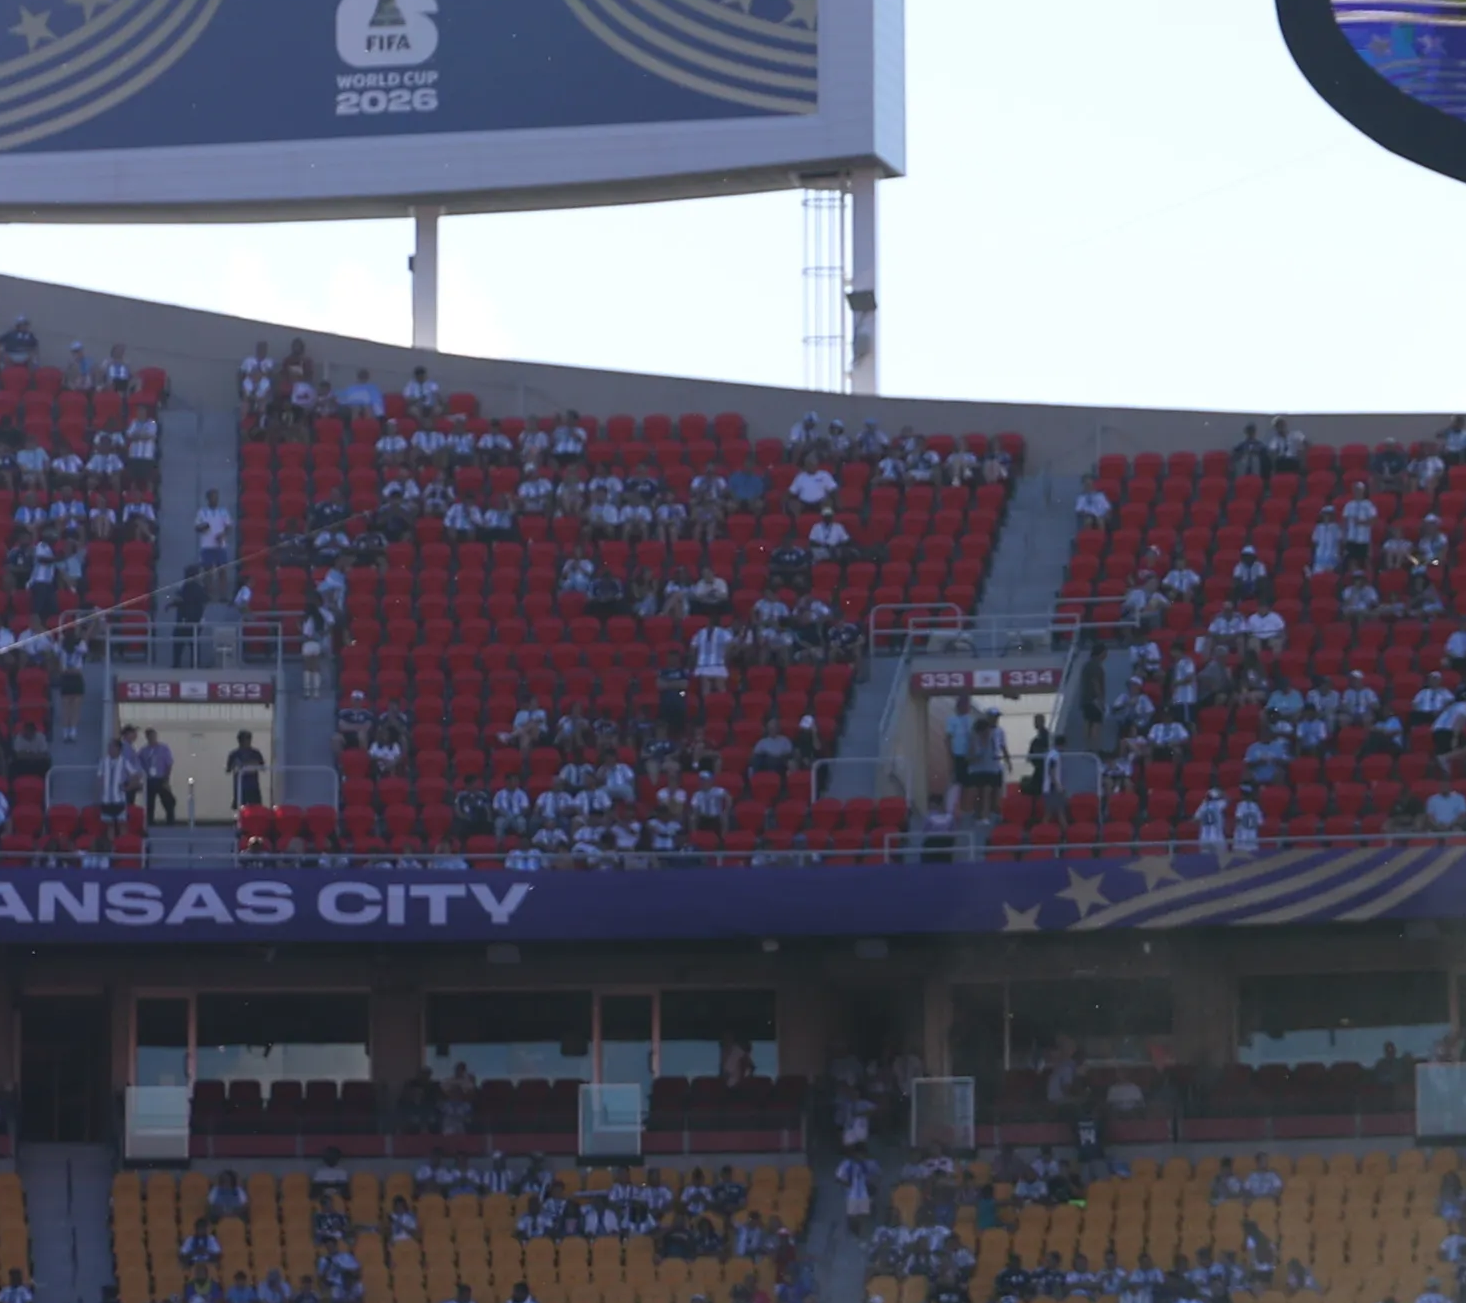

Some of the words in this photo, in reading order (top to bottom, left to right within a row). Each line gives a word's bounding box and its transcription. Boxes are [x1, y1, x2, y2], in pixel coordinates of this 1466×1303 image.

[366, 33, 411, 53] FIFA
[336, 72, 400, 89] WORLD
[403, 70, 439, 86] CUP
[336, 88, 439, 116] 2026
[920, 672, 965, 688] 333
[1009, 670, 1054, 686] 334
[126, 683, 171, 697] 332
[217, 683, 262, 697] 333
[316, 881, 530, 926] CITY
